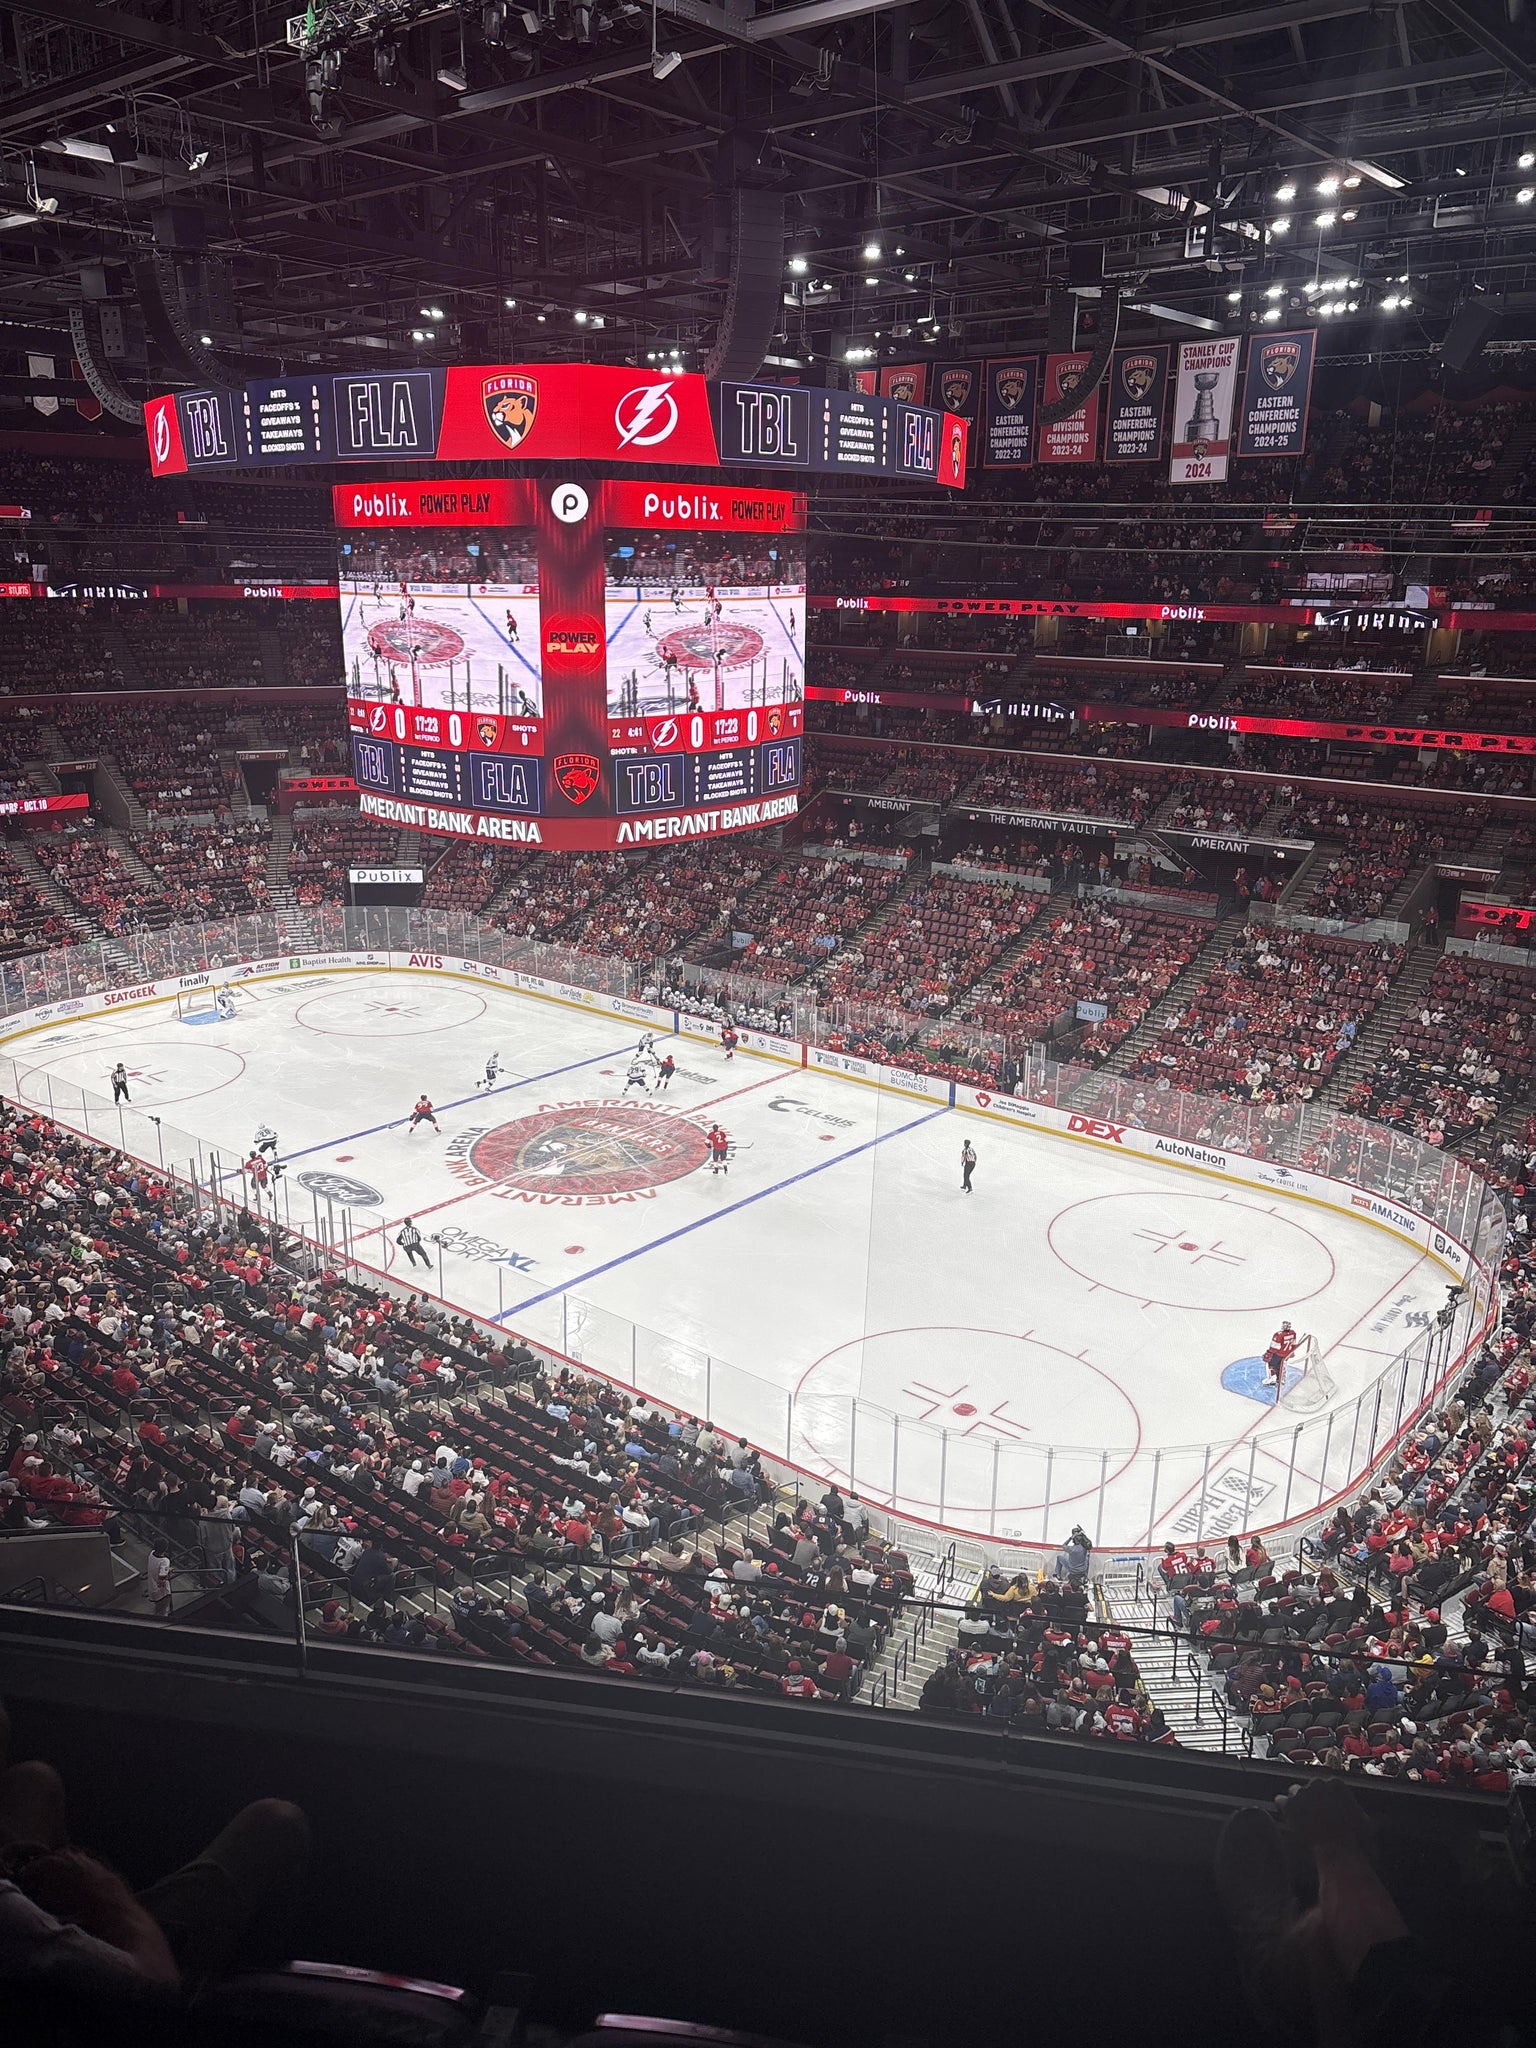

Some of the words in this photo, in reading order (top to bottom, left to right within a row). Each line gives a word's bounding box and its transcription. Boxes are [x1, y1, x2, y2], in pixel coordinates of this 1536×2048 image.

[1183, 345, 1216, 359] STANLEY
[1218, 343, 1236, 356] CUP
[1265, 346, 1296, 356] FLORIDA
[1184, 356, 1232, 371] CHAMPIONS
[487, 377, 533, 393] FLORIDA
[270, 389, 287, 399] HITS
[259, 402, 294, 413] FACEOFFS
[851, 402, 865, 412] HITS
[1257, 396, 1294, 409] EASTERN
[348, 381, 418, 448] FLA
[1120, 406, 1152, 418] EASTERN
[1248, 409, 1300, 422] CONFERENCE
[261, 415, 301, 427] GIVEAWAYS
[736, 390, 797, 456] TBL
[839, 414, 870, 426] FACEOFFS
[995, 414, 1024, 425] EASTERN
[1112, 418, 1157, 430] CONFERENCE
[186, 397, 228, 458] TBL
[840, 427, 874, 439] GIVEAWAYS
[990, 425, 1029, 437] CONFERENCE
[1052, 421, 1085, 432] DIVISION
[1248, 422, 1297, 435] CHAMPIONS
[261, 429, 303, 440] TAKEAWAYS
[904, 412, 933, 470] FLA
[1046, 432, 1090, 444] CHAMPIONS
[1113, 430, 1155, 442] CHAMPIONS
[261, 443, 286, 453] BLOCKED
[285, 442, 305, 452] SHOTS
[838, 440, 875, 452] TAKEAWAYS
[990, 437, 1027, 448] CHAMPIONS
[1117, 443, 1148, 453] 2023-24
[1254, 435, 1289, 448] 2024-25
[995, 449, 1022, 460] 2022-23
[1051, 445, 1082, 456] 2023-24
[837, 452, 860, 463] BLOCKED
[859, 454, 875, 464] SHOTS
[1185, 463, 1212, 478] 2024
[353, 492, 408, 517] Publix
[419, 494, 457, 514] POWER
[461, 493, 491, 513] PLAY
[644, 493, 720, 520] Publix
[731, 500, 765, 521] POWER
[767, 503, 786, 521] PLAY
[243, 586, 283, 599] Publix
[836, 597, 869, 609] Publix
[936, 601, 1011, 611] POWER
[1021, 603, 1080, 613] PLAY
[1161, 606, 1204, 620] Publix
[550, 632, 597, 643] POWER
[546, 642, 601, 653] PLAY
[844, 690, 880, 704] Publix
[395, 707, 406, 740] 0
[415, 715, 438, 733] 17:23
[448, 714, 462, 747] 0
[511, 724, 538, 733] SHOTS
[690, 715, 703, 748] 0
[715, 717, 738, 735] 17:23
[747, 710, 758, 742] 0
[1188, 714, 1238, 731] Publix
[1346, 728, 1463, 747] POWER
[420, 750, 435, 759] HITS
[610, 747, 638, 755] SHOTS:
[719, 751, 734, 761] HITS
[358, 743, 389, 785] TBL
[411, 759, 442, 769] FACEOFFS
[557, 755, 597, 767] FLORIDA
[708, 761, 738, 771] FACEOFFS
[768, 746, 795, 786] FLA
[412, 768, 447, 780] GIVEAWAYS
[708, 769, 743, 781] GIVEAWAYS
[411, 778, 449, 790] TAKEAWAYS
[480, 761, 529, 805] FLA
[626, 762, 676, 805] TBL
[707, 779, 744, 791] TAKEAWAYS
[409, 786, 434, 798] BLOCKED
[434, 790, 454, 800] SHOTS
[703, 791, 730, 801] BLOCKED
[729, 787, 747, 797] SHOTS
[868, 799, 911, 812] AMERANT
[360, 793, 426, 827] AMERANT
[428, 809, 474, 834] BANK
[476, 815, 543, 844] ARENA
[616, 810, 720, 844] AMERANT
[721, 804, 760, 829] BANK
[760, 795, 799, 821] ARENA
[989, 813, 1007, 825] THE
[1008, 816, 1057, 831] AMERANT
[1061, 822, 1098, 835] VAULT
[1191, 837, 1250, 854] AMERANT
[357, 870, 412, 882] Publix
[1436, 867, 1451, 877] 103
[1481, 873, 1497, 882] 104
[256, 962, 280, 970] ACTION
[302, 957, 327, 967] Baptist
[328, 956, 352, 966] Health
[408, 954, 442, 969] AVIS
[179, 974, 210, 988] finally
[104, 984, 157, 1006] SEATGEEK
[1076, 1005, 1106, 1018] Publix
[890, 1069, 928, 1085] COMCAST
[890, 1077, 929, 1093] BUSINESS
[537, 1099, 682, 1113] AMERANT
[796, 1106, 857, 1128] CELSIUS
[1066, 1114, 1127, 1144] DEX
[446, 1126, 491, 1158] ARENA
[579, 1119, 675, 1155] PANTHERS
[715, 1134, 724, 1143] 2
[1155, 1139, 1226, 1168] AutoNation
[445, 1160, 489, 1188] BANK
[1257, 1172, 1276, 1184] Disney
[1275, 1177, 1295, 1189] CRUISE
[1295, 1182, 1309, 1192] LINE
[310, 1177, 364, 1202] Ford
[491, 1189, 657, 1207] AMERANT
[1371, 1202, 1416, 1232] AMAZING
[1173, 1562, 1188, 1575] 16
[806, 1572, 820, 1588] 72
